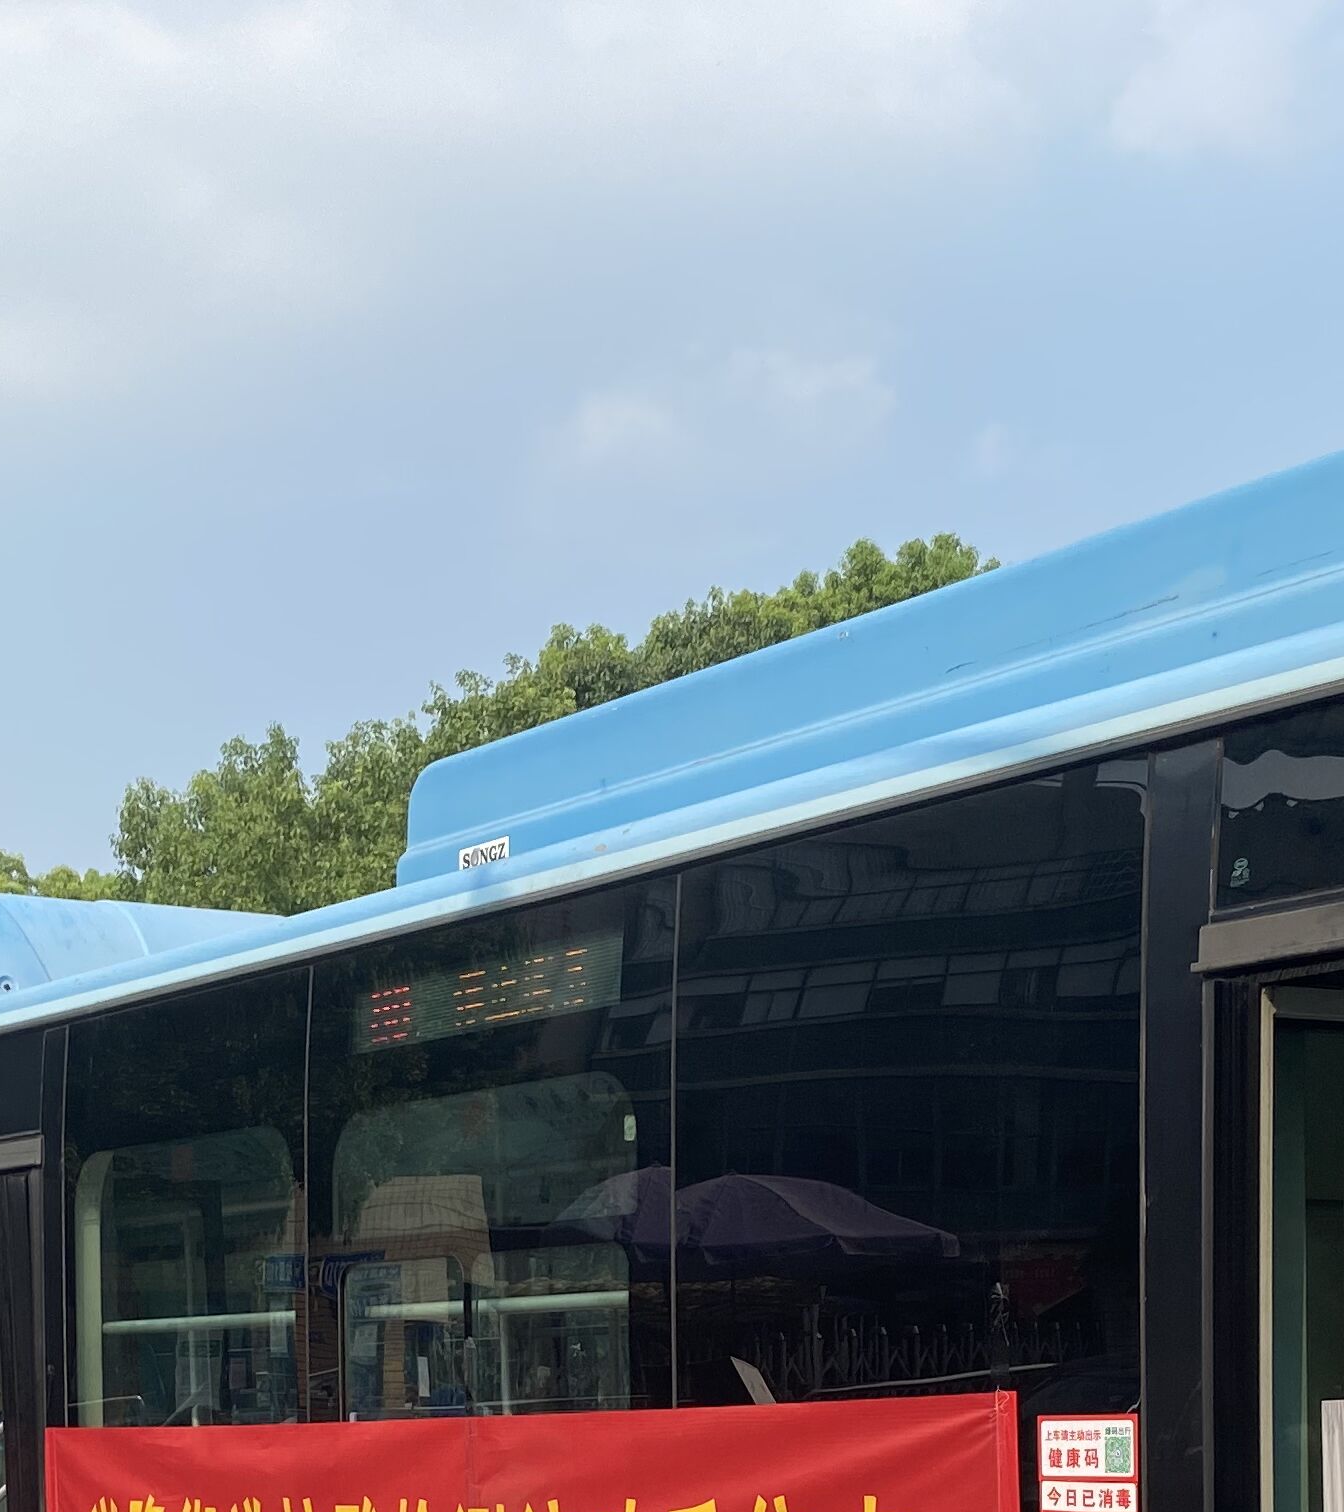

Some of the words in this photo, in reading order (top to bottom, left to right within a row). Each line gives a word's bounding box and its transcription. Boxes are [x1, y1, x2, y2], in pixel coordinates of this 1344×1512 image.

[462, 842, 506, 869] SONGZ
[1044, 1429, 1102, 1442] 上车请主动出示
[1048, 1447, 1099, 1469] 健康码
[1046, 1486, 1132, 1510] 今日已消毒
